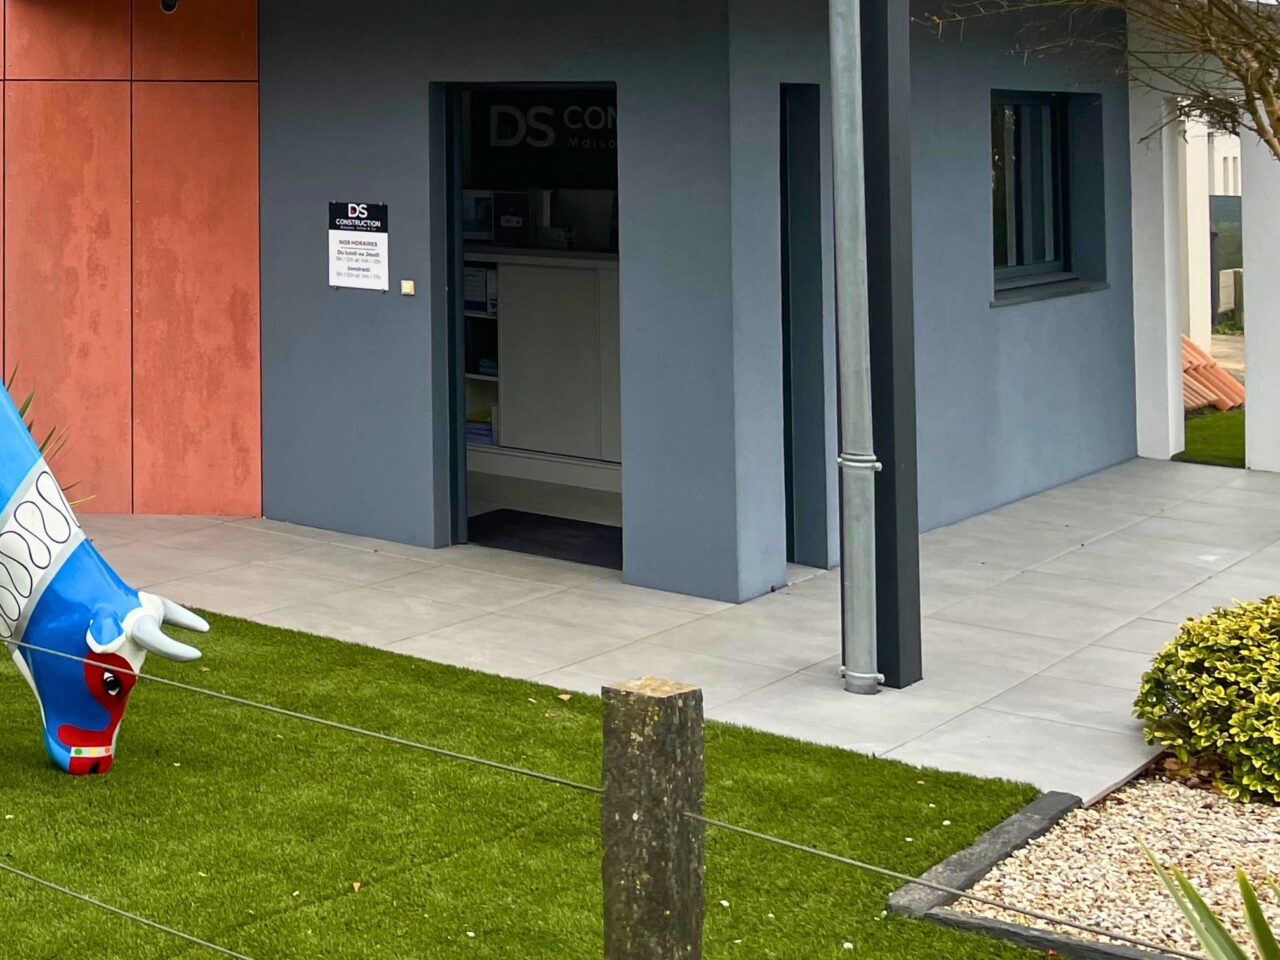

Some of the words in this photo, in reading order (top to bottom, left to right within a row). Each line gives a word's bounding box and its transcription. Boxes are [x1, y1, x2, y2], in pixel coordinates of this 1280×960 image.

[490, 105, 556, 148] DS
[348, 203, 368, 218] DS
[336, 218, 381, 227] CONSTRUCTION
